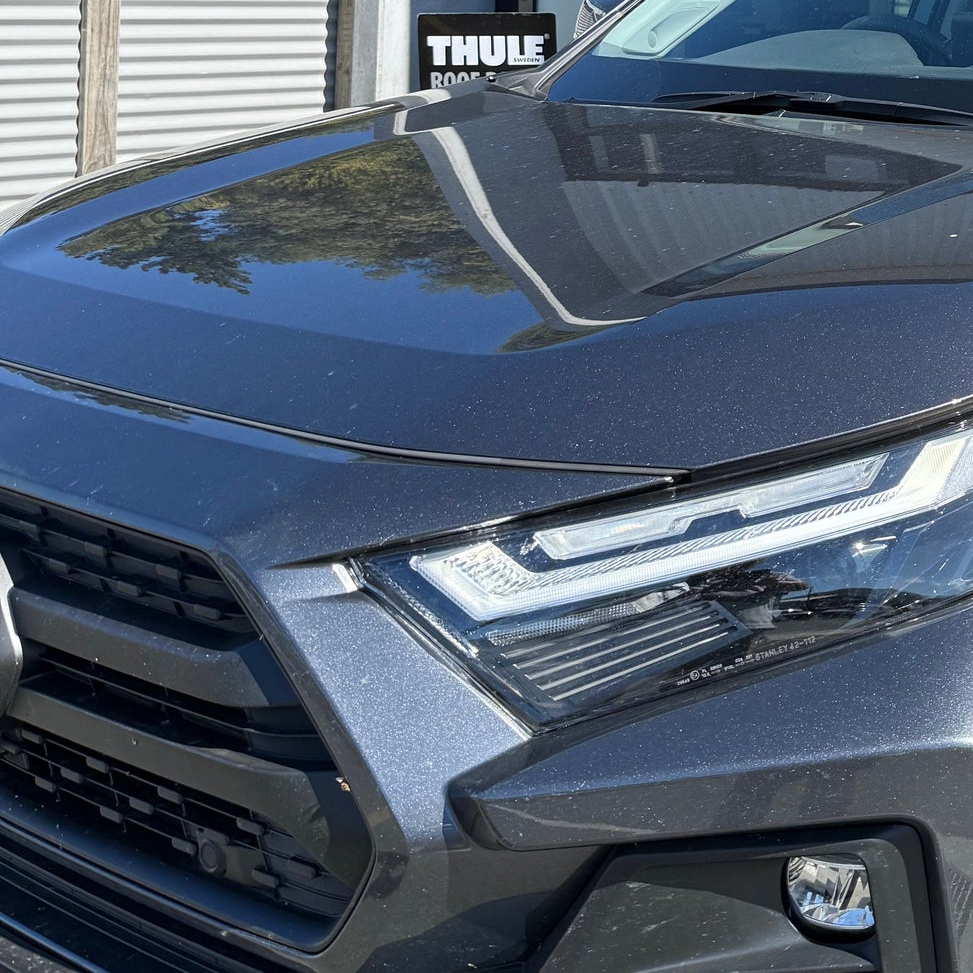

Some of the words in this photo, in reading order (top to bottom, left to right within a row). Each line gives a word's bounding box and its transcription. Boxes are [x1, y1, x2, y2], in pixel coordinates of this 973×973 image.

[426, 35, 545, 67] THULE
[755, 644, 788, 661] STANLEY
[789, 635, 817, 650] 42-112
